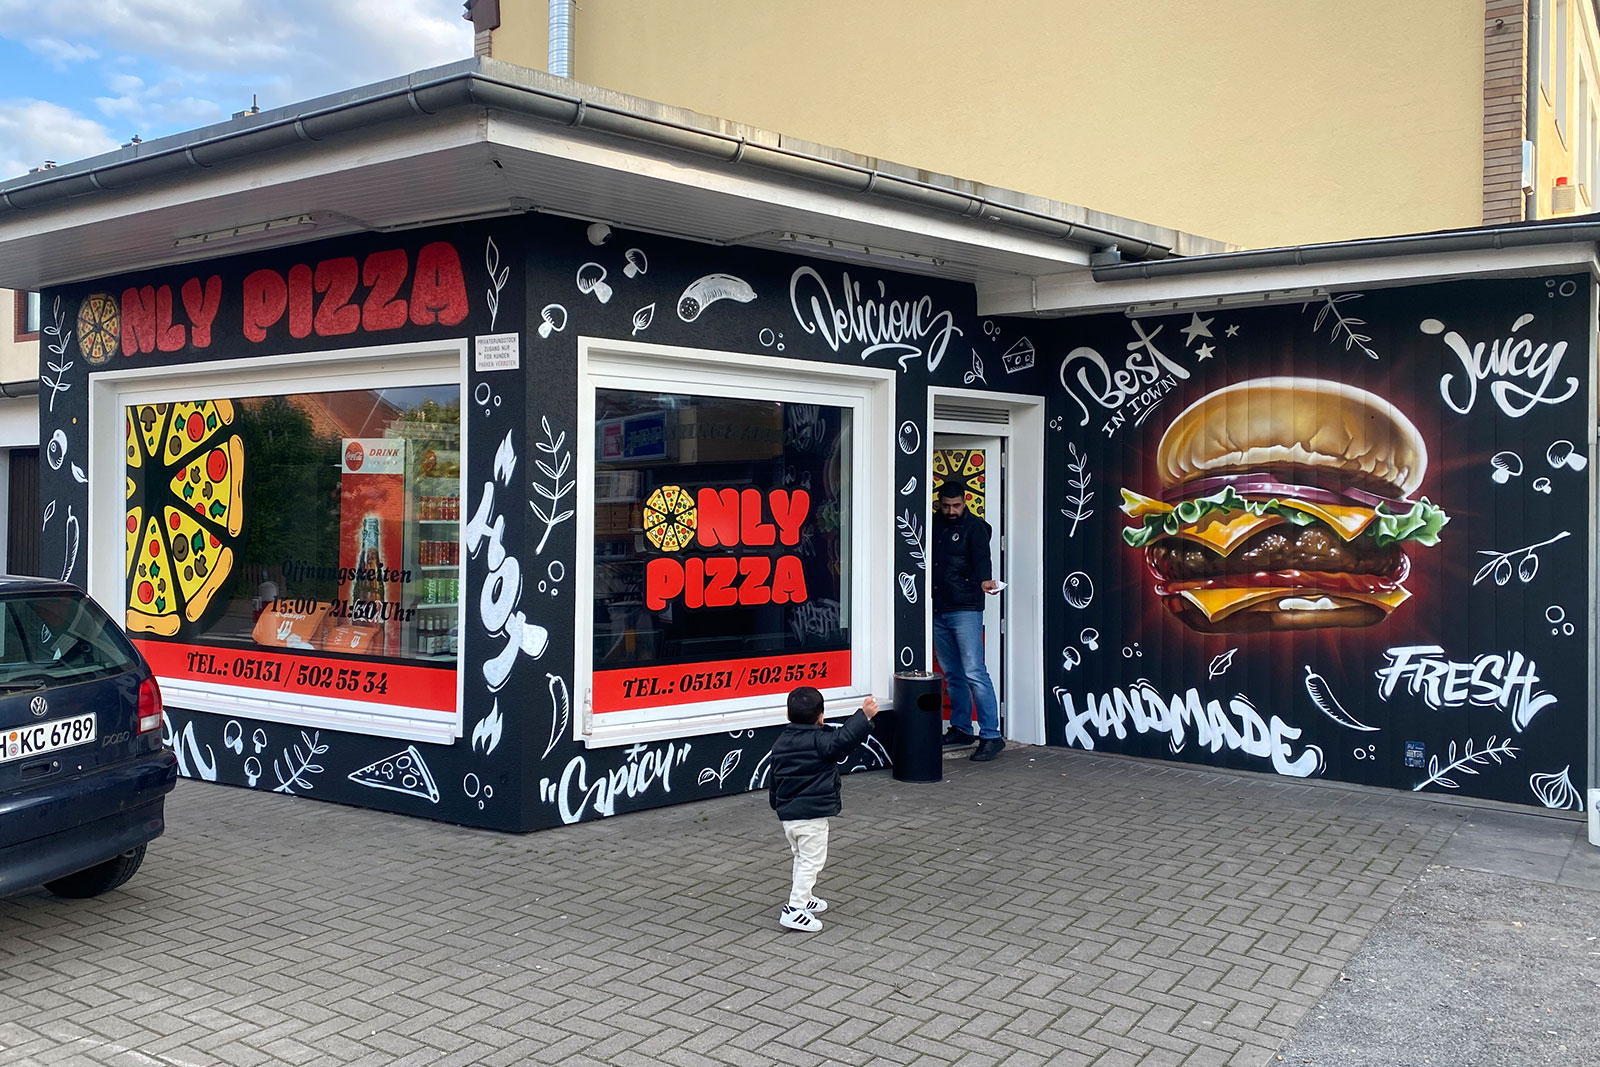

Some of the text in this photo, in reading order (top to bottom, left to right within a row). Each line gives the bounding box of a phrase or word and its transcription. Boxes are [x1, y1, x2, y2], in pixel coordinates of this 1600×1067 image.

[243, 241, 469, 342] PIZZA
[790, 266, 963, 372] Delicious
[1060, 320, 1191, 426] Best
[1102, 374, 1178, 438] IN TOWN
[369, 448, 400, 457] DRINK
[282, 559, 412, 586] Öffnungszeiten
[466, 481, 549, 690] HOT
[646, 555, 809, 610] PIZZA
[271, 598, 318, 616] 15:00
[381, 601, 416, 622] Uhr
[187, 651, 228, 676] TEL.:
[232, 658, 282, 682] 05131
[297, 665, 333, 688] 502
[336, 669, 361, 691] 55
[363, 672, 388, 694] 34
[623, 677, 675, 698] TEL.:
[680, 670, 733, 693] 05131
[748, 665, 782, 686] 502
[784, 664, 806, 682] 55
[808, 662, 828, 680] 34
[1376, 645, 1558, 729] FRESH
[20, 727, 46, 754] KC
[50, 717, 94, 747] 6789
[1061, 687, 1318, 777] HANDMADE
